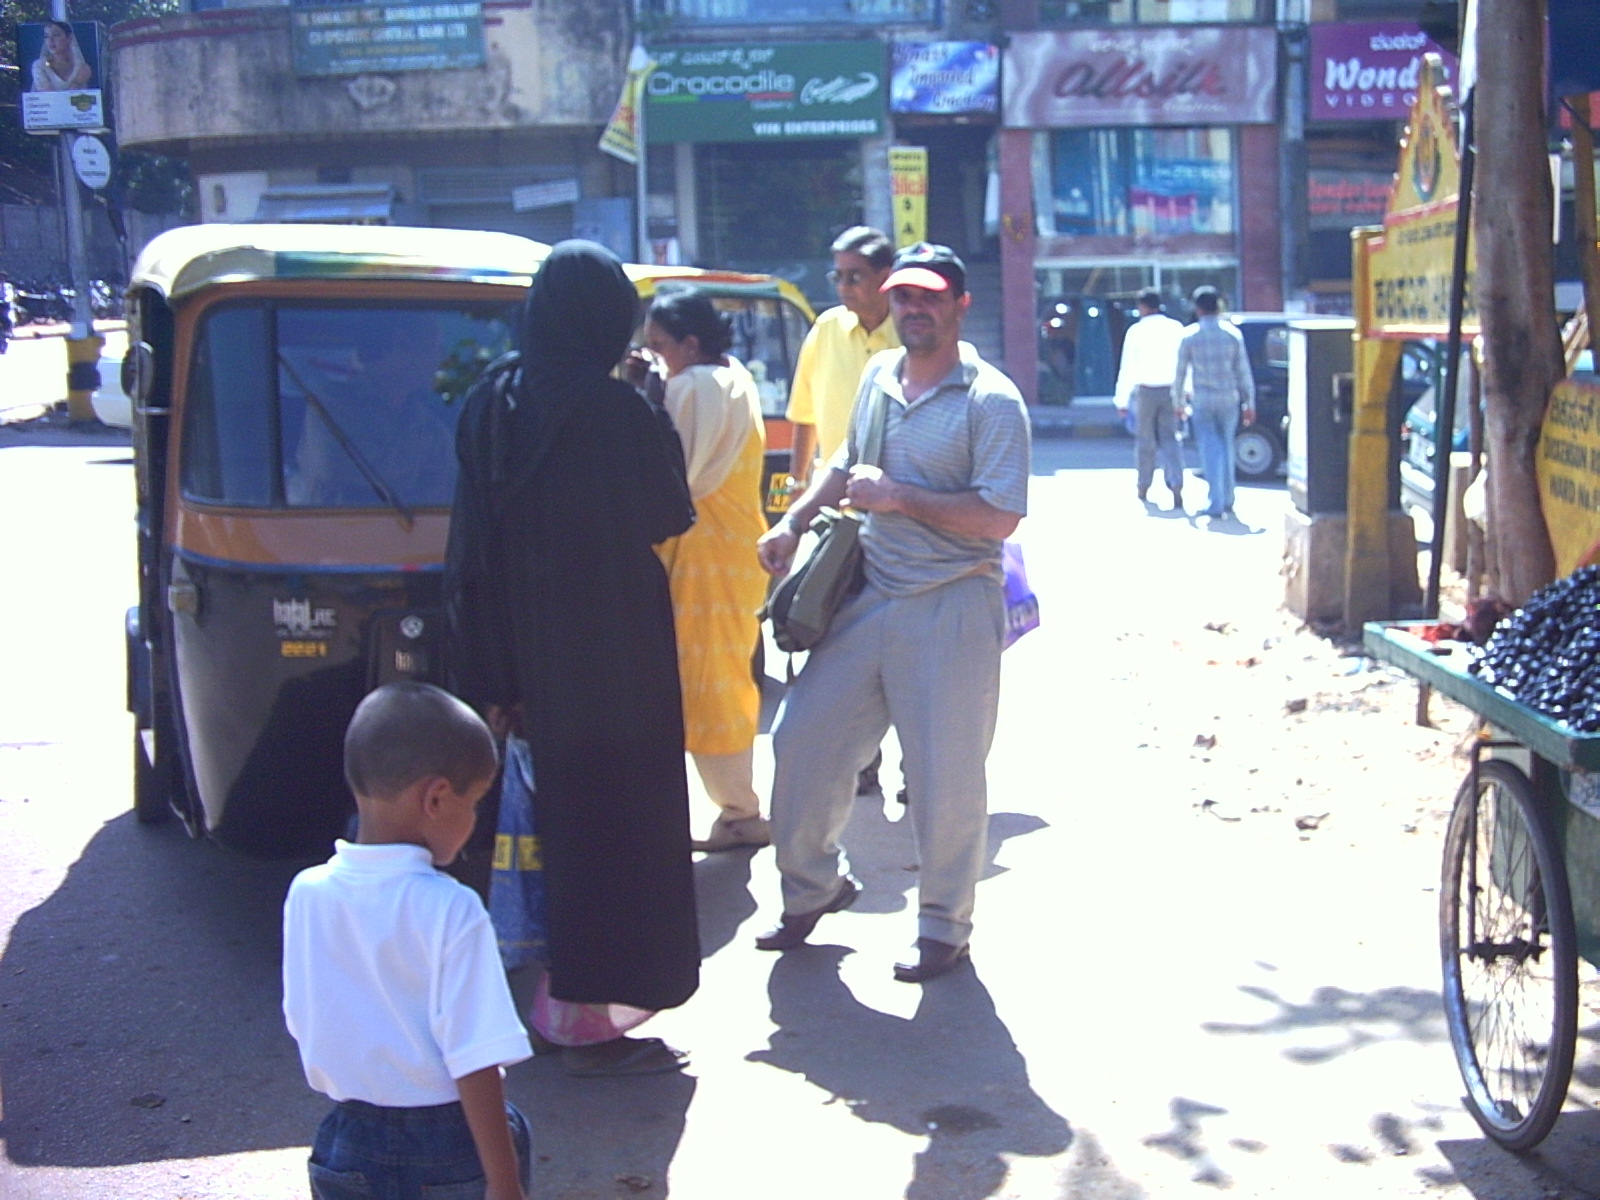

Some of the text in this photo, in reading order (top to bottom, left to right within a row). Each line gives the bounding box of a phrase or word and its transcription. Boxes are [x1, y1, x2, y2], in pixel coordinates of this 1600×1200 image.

[648, 69, 795, 95] Crocodile
[1324, 57, 1450, 91] Wond
[1325, 92, 1418, 108] VIDEO
